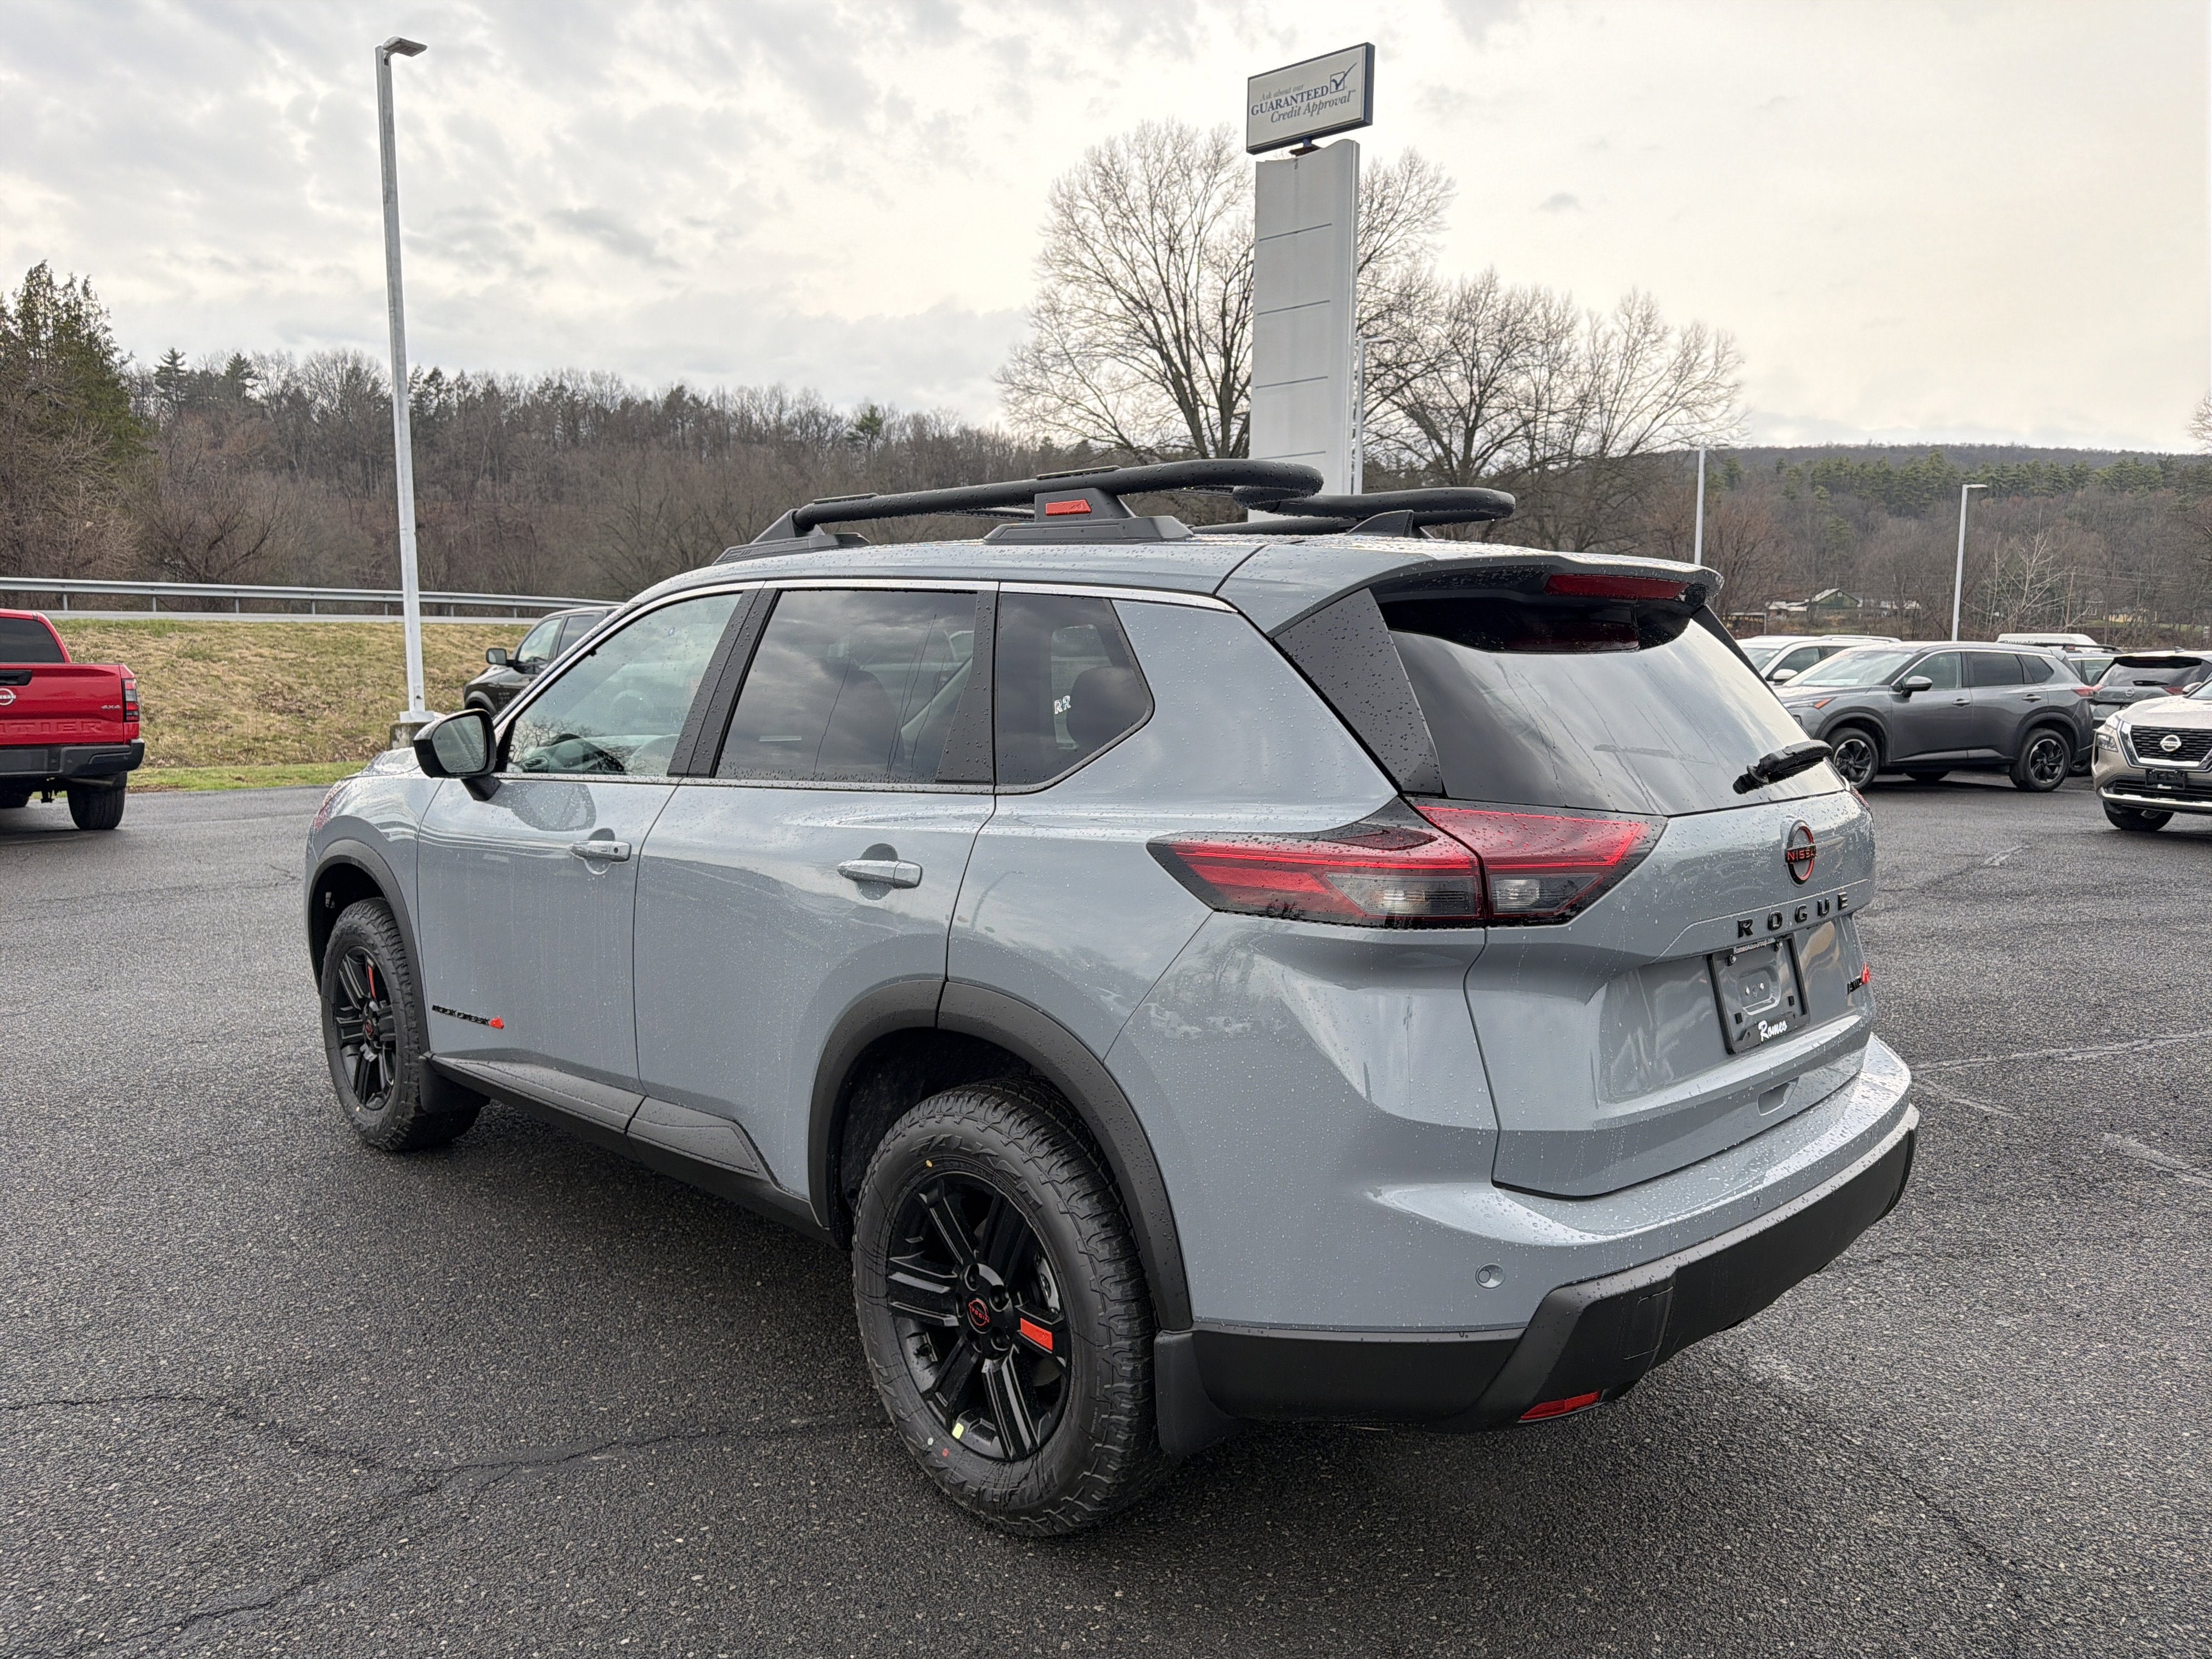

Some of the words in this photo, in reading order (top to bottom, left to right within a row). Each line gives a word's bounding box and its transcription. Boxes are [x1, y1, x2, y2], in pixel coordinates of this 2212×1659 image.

[1251, 85, 1329, 116] GUARANTEED
[1260, 92, 1272, 101] Ask
[1273, 87, 1291, 98] about
[1293, 84, 1304, 92] our
[1271, 106, 1301, 123] Credit
[1302, 90, 1352, 117] Approval
[0, 722, 103, 734] TIER
[1738, 891, 1848, 938] ROGUE
[1758, 1020, 1787, 1042] Romeo
